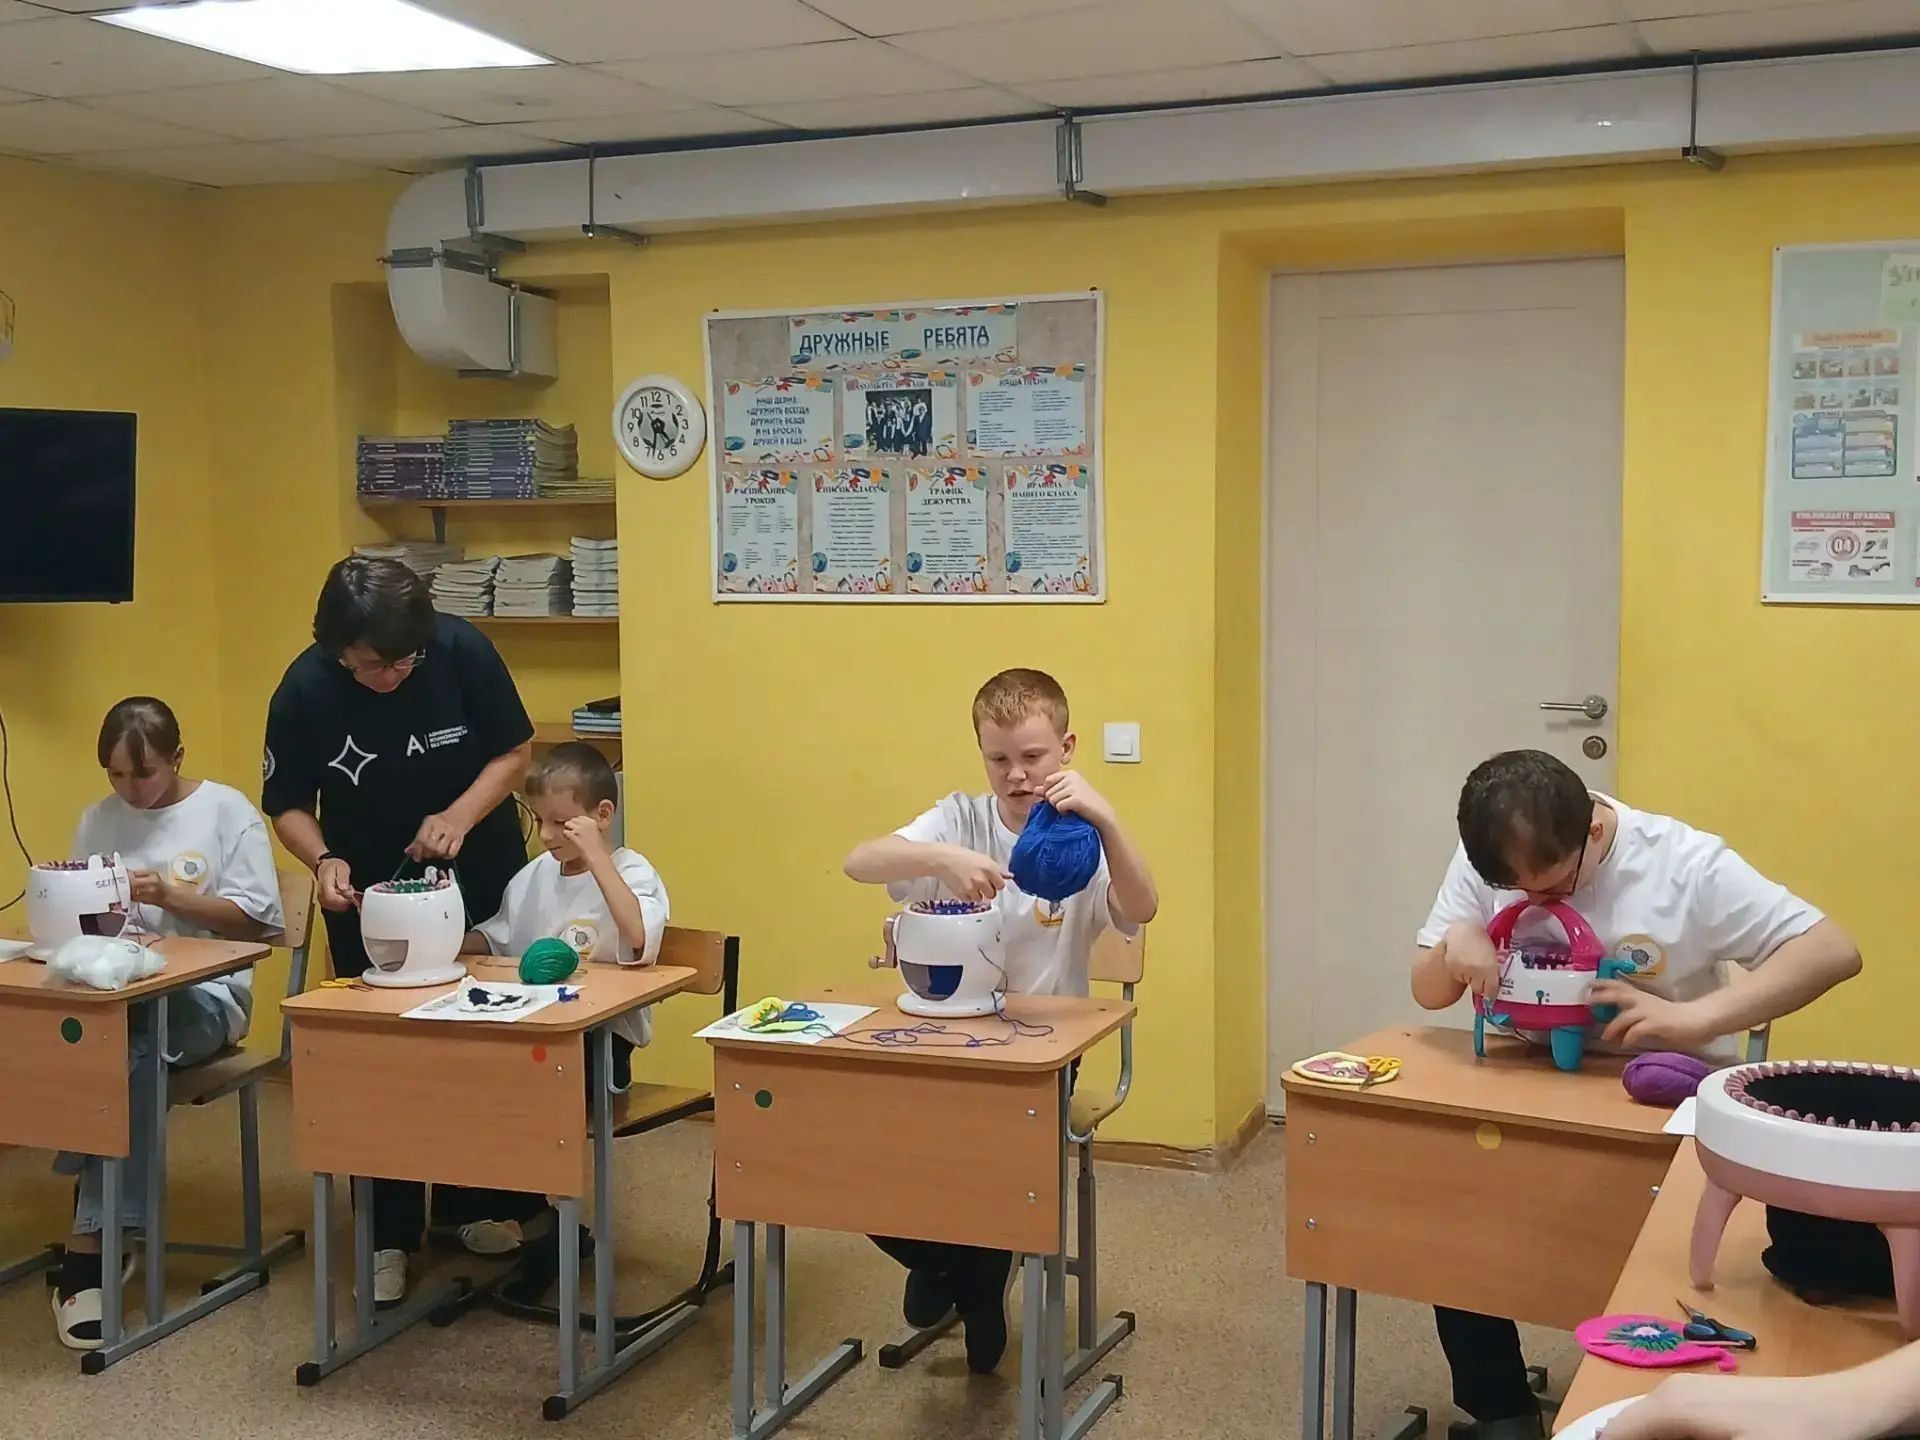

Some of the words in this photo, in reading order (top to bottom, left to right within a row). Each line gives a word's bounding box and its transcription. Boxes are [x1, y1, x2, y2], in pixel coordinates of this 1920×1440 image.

[800, 331, 889, 352] ДРУЖНЫЕ
[924, 325, 989, 346] РЕБЯТА
[640, 396, 648, 407] 11
[651, 391, 661, 402] 12
[666, 394, 671, 405] 1
[631, 408, 641, 419] 10
[676, 404, 683, 416] 2
[627, 422, 634, 432] 9
[682, 419, 689, 430] 3
[633, 436, 639, 447] 8
[679, 434, 685, 444] 4
[645, 446, 651, 457] 7
[657, 449, 664, 460] 6
[670, 445, 677, 456] 5
[929, 487, 964, 495] ГРАФИК
[921, 497, 972, 505] ДЕЖУРСТВА
